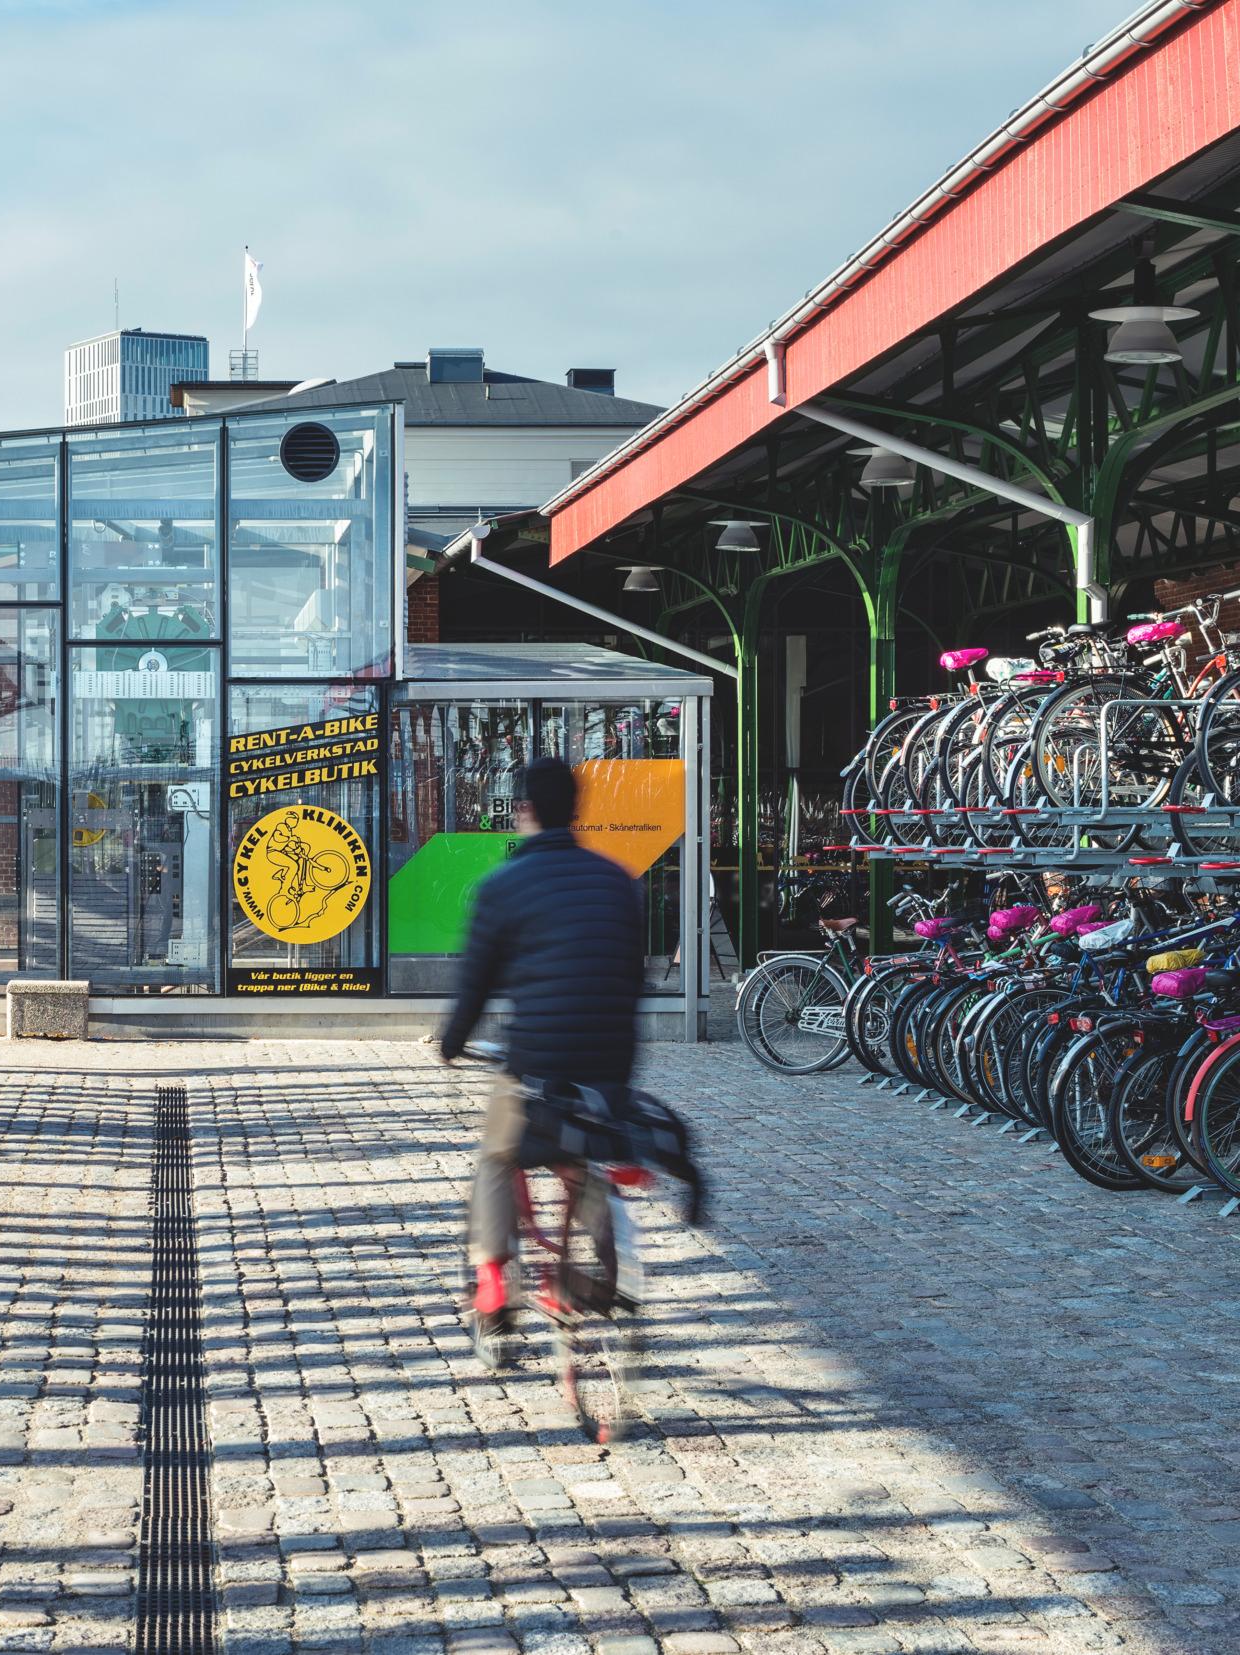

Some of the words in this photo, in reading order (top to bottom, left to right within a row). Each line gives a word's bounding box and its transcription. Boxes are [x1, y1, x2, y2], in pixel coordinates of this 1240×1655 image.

[230, 714, 378, 753] RENT-A-BIKE
[230, 738, 379, 774] CYKELVERKSTAD
[229, 759, 378, 798] CYKELBUTIK
[609, 823, 662, 832] Skånetrafiken
[237, 984, 275, 993] trappa
[330, 983, 339, 991] &
[251, 971, 270, 980] Vår
[272, 972, 301, 980] butik
[304, 972, 337, 982] ligger
